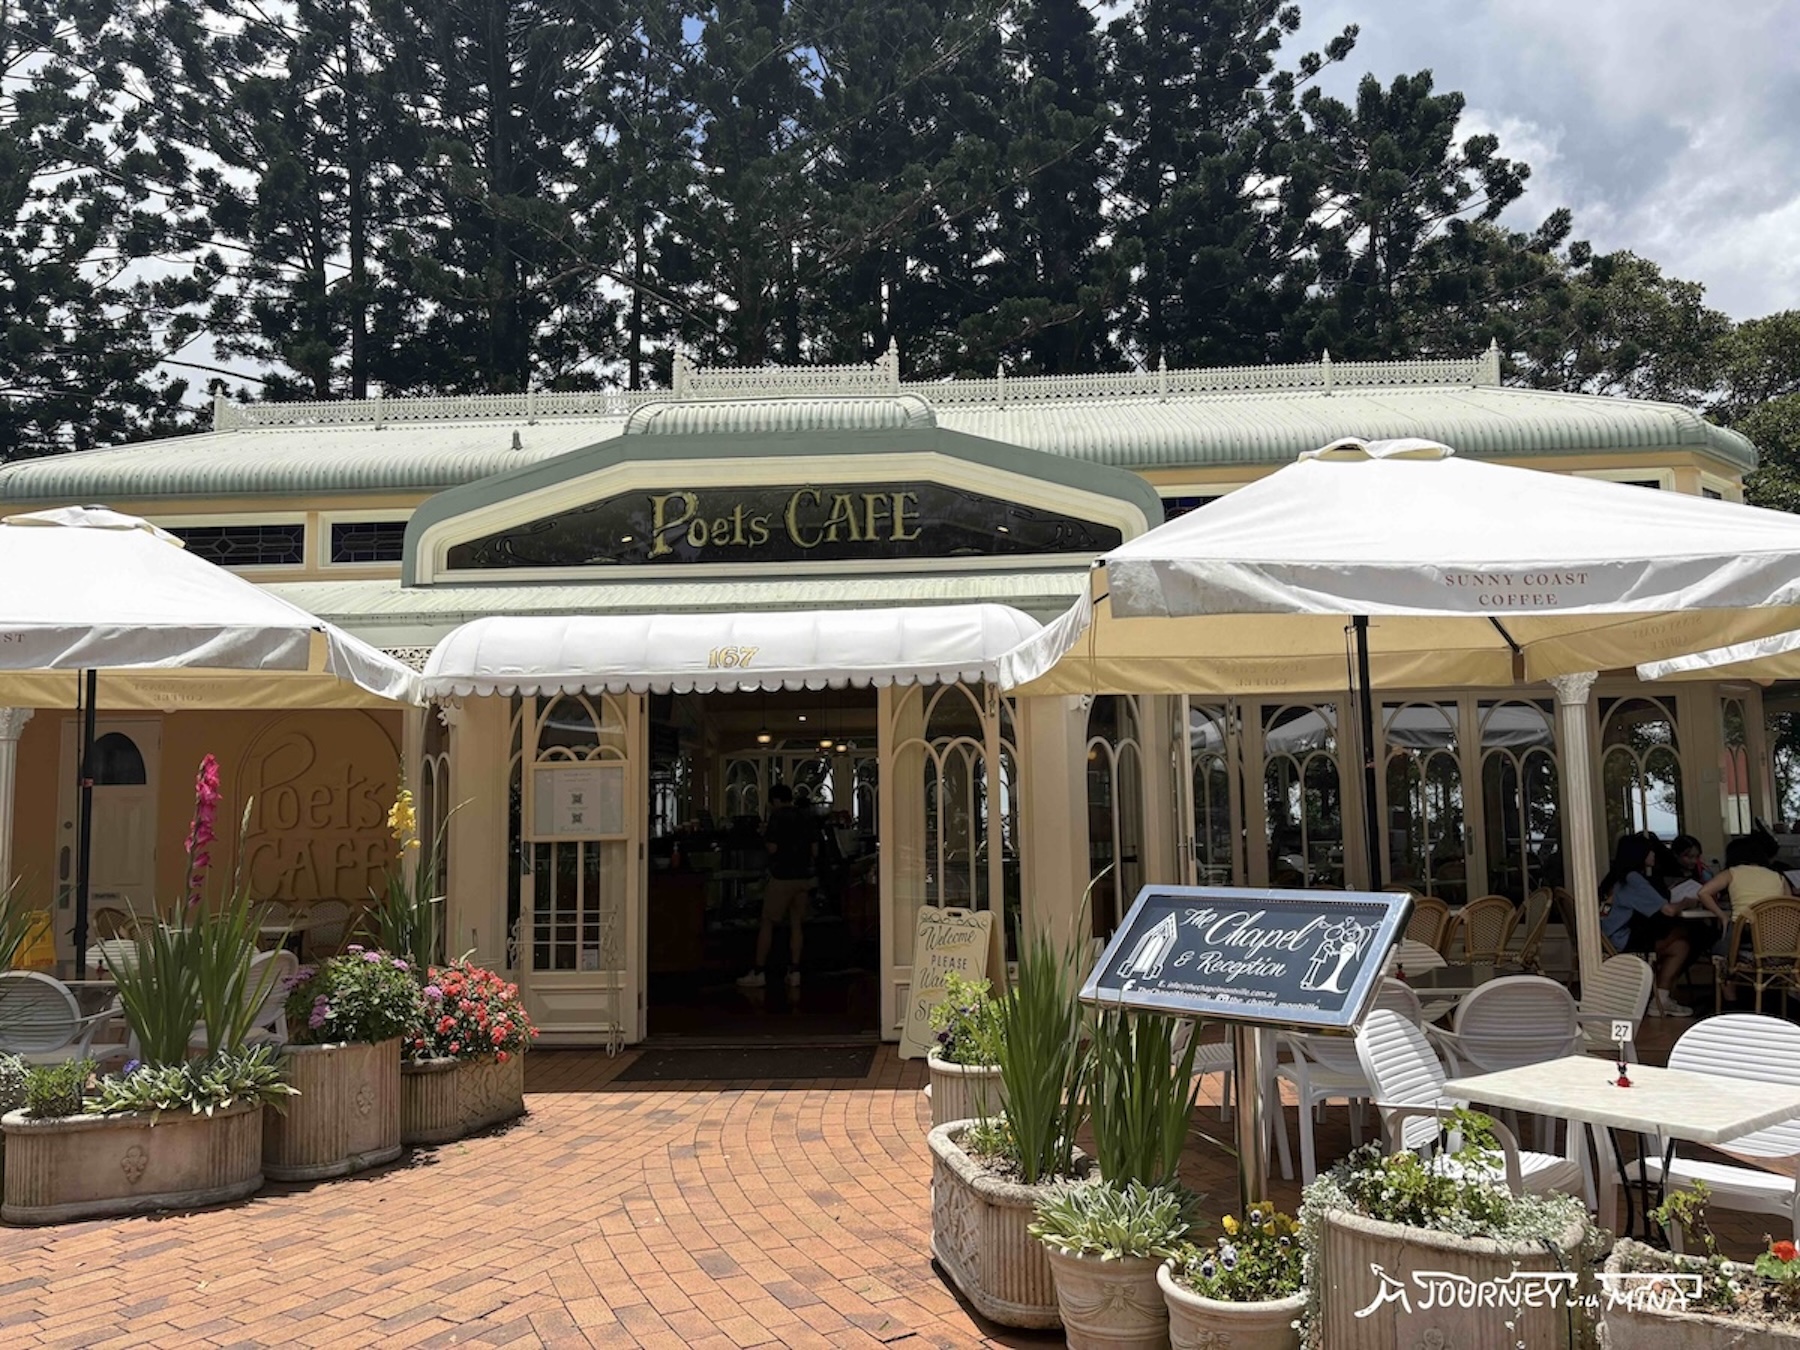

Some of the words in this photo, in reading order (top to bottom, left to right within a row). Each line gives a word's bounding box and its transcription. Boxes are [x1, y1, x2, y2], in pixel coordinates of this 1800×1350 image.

[647, 491, 772, 560] Poets
[784, 486, 922, 549] CAFE
[1444, 573, 1515, 587] SUNNY
[1523, 572, 1589, 586] COAST
[1478, 593, 1558, 606] COFFEE
[708, 645, 760, 669] 167
[247, 731, 387, 839] Poets
[250, 838, 390, 901] CAFE
[920, 925, 978, 951] Welcome
[1179, 907, 1218, 929] The
[1204, 910, 1327, 960] Chapel
[931, 954, 968, 970] PLEASE
[1173, 950, 1195, 967] &
[1196, 950, 1288, 983] Reception
[919, 967, 954, 989] Wai
[1615, 1024, 1630, 1038] 27
